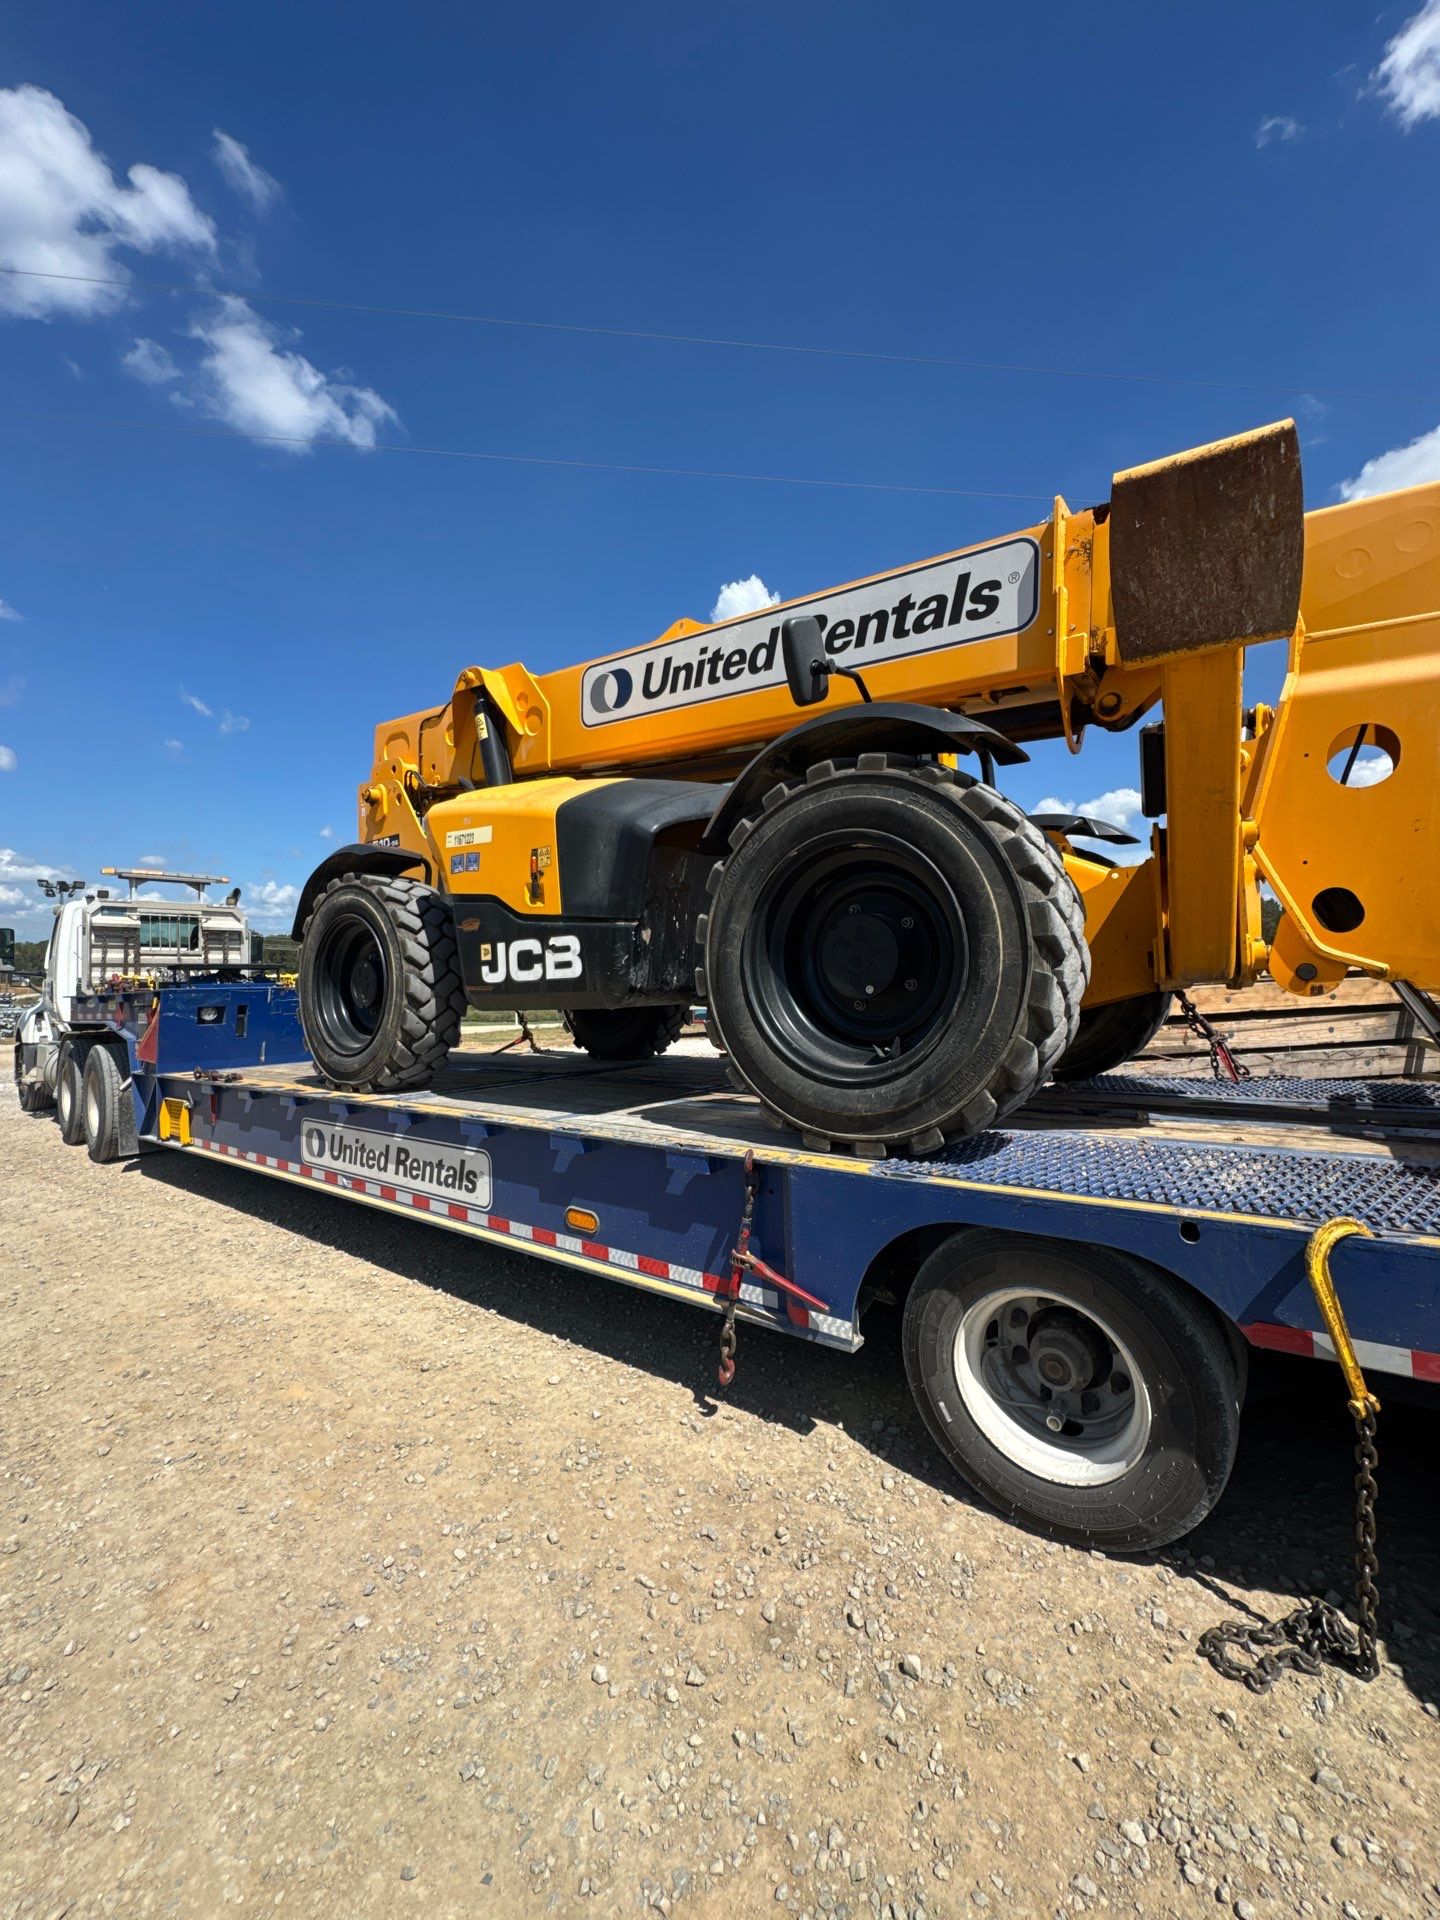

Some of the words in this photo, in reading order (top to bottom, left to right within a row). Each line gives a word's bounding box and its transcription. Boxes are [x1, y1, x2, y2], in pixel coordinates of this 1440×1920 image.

[642, 627, 780, 700] United
[481, 934, 583, 984] JCB
[329, 1133, 390, 1173] United
[394, 1146, 479, 1194] Rentals
